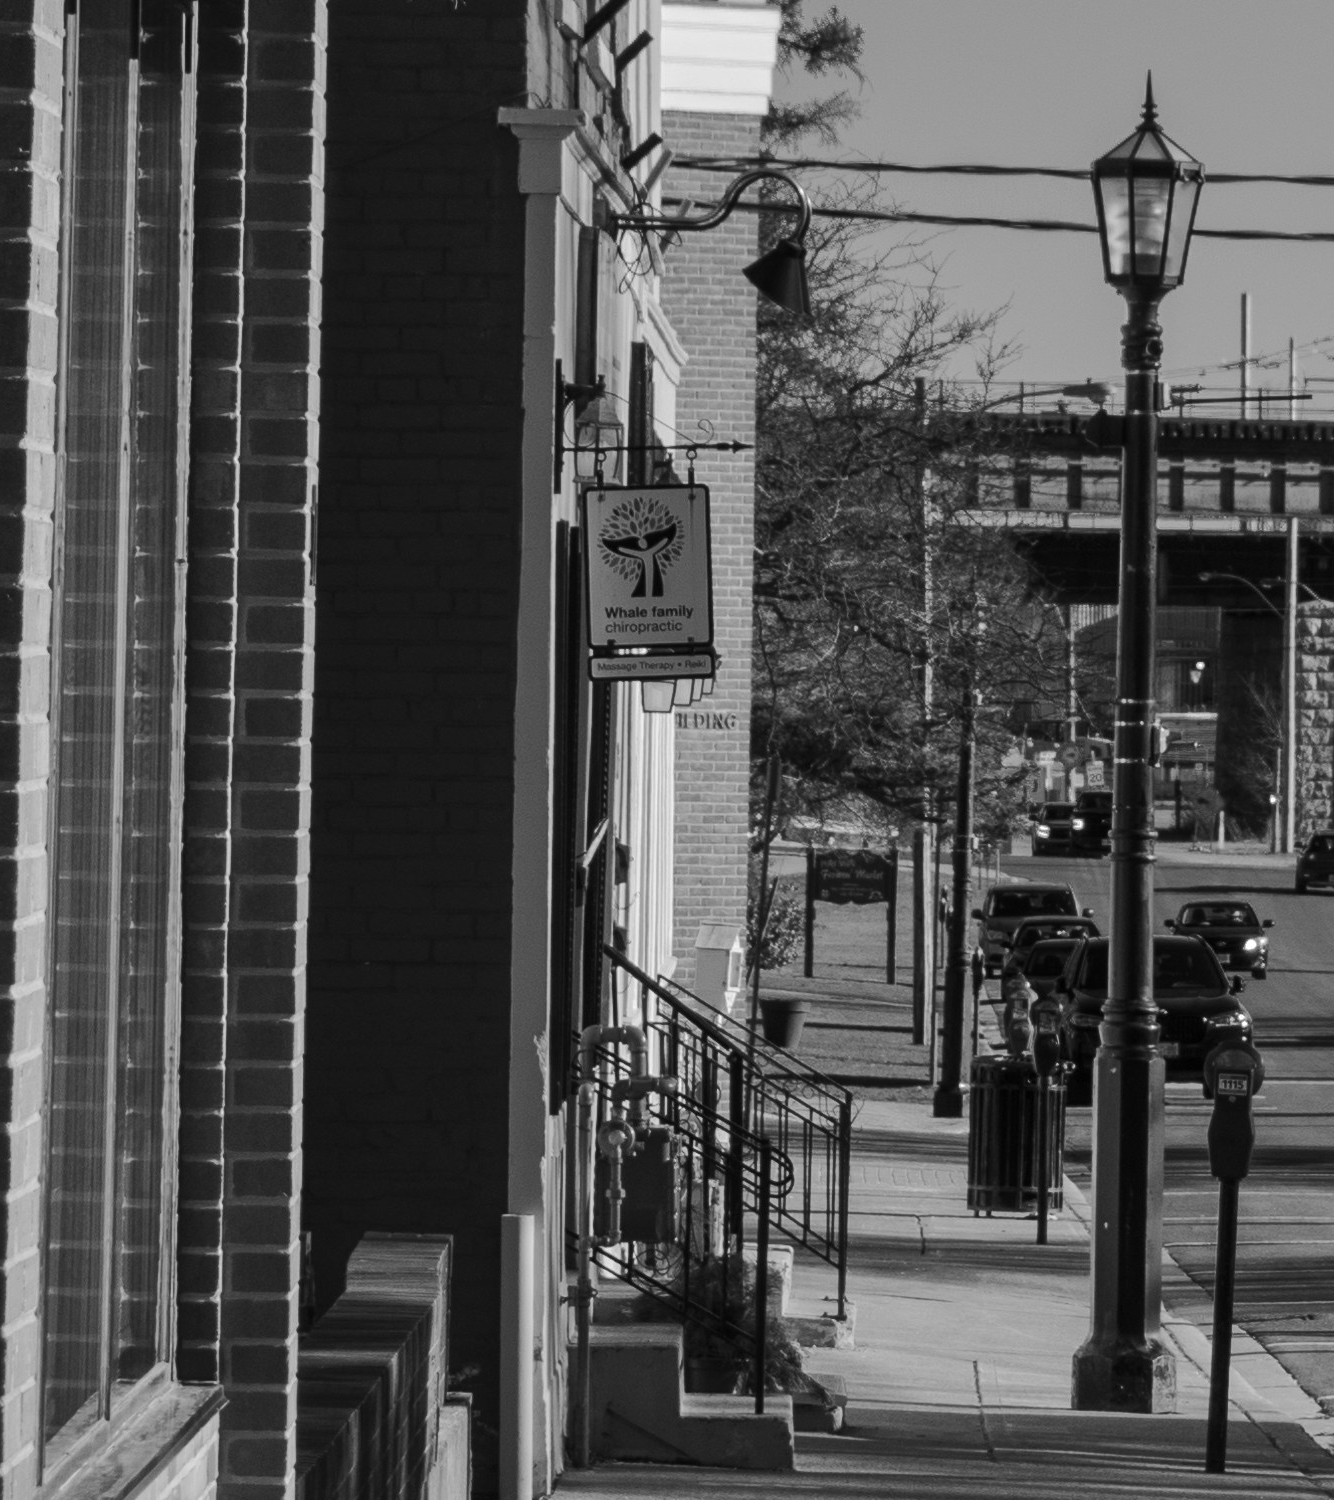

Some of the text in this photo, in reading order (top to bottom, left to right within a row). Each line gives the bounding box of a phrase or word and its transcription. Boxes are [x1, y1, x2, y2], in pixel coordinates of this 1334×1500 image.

[604, 605, 694, 619] Whale family
[605, 620, 683, 634] chiropractic
[597, 660, 707, 672] Massage Therapy Reiki
[1221, 1079, 1244, 1090] 1115
